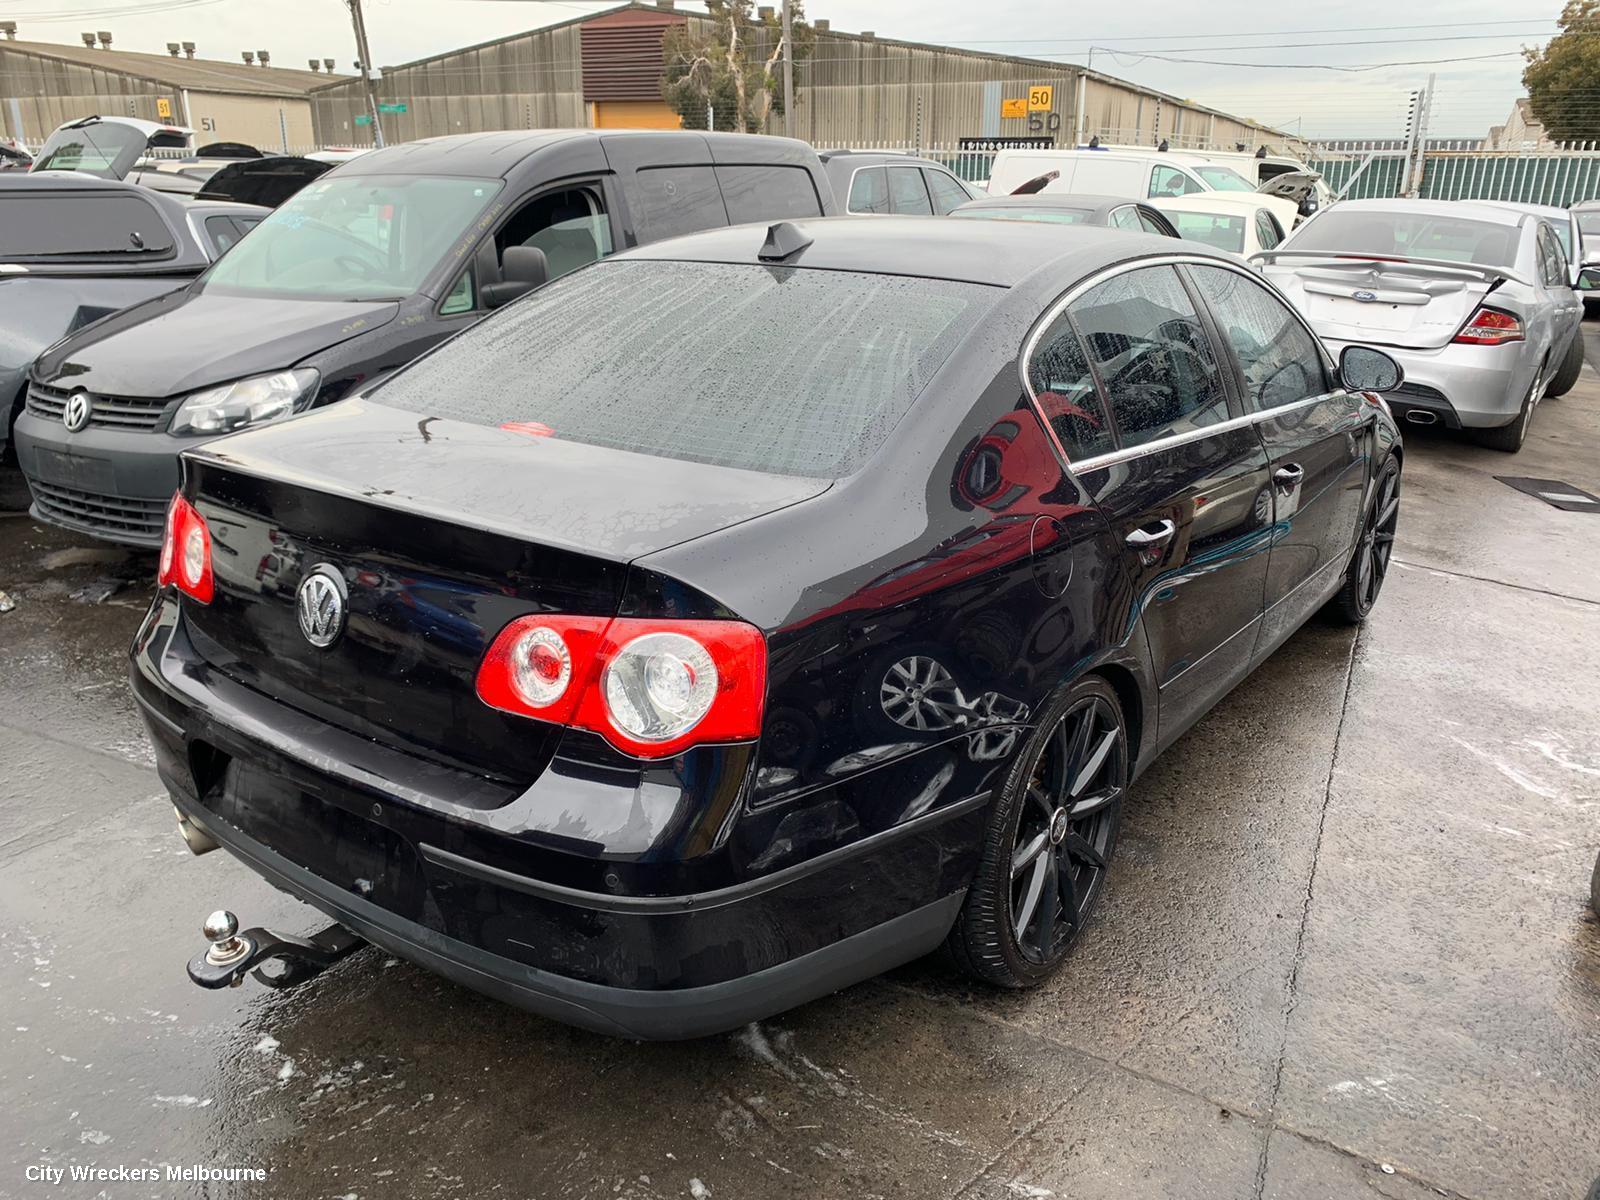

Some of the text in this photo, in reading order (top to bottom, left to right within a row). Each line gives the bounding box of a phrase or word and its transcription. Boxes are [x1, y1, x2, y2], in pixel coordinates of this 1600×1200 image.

[1031, 91, 1049, 105] 50
[159, 103, 168, 113] 51
[201, 118, 216, 132] 51
[1028, 112, 1060, 131] 50
